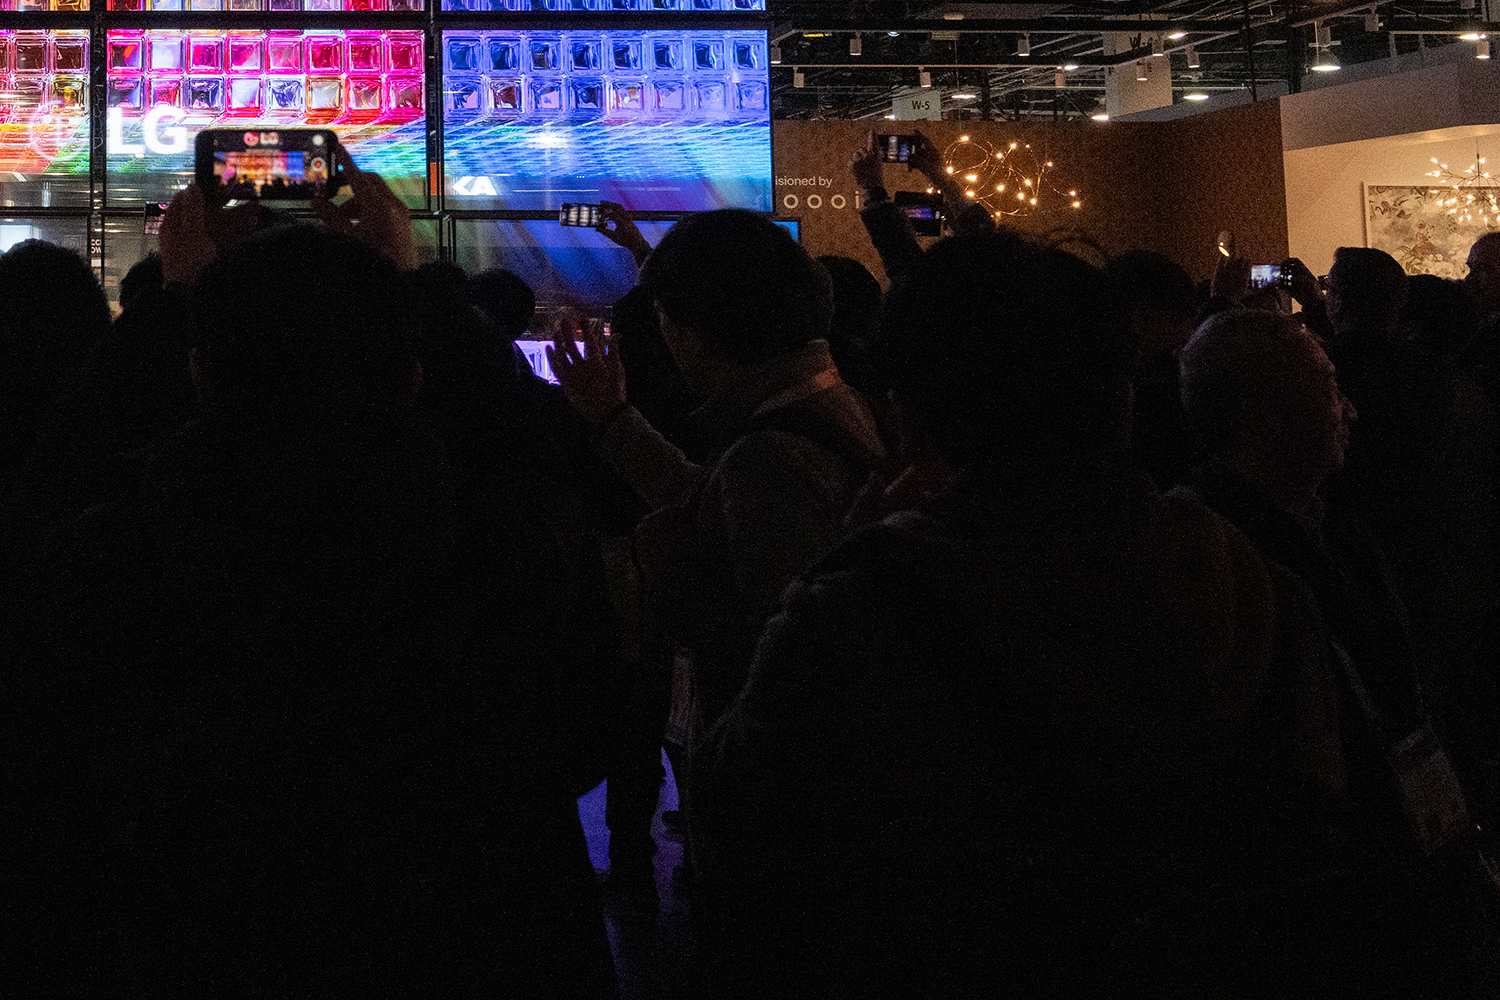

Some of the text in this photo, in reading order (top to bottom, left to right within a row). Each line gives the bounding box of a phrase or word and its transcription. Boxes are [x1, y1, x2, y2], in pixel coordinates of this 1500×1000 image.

[106, 104, 188, 155] LG
[260, 131, 279, 145] LG
[818, 175, 833, 189] by
